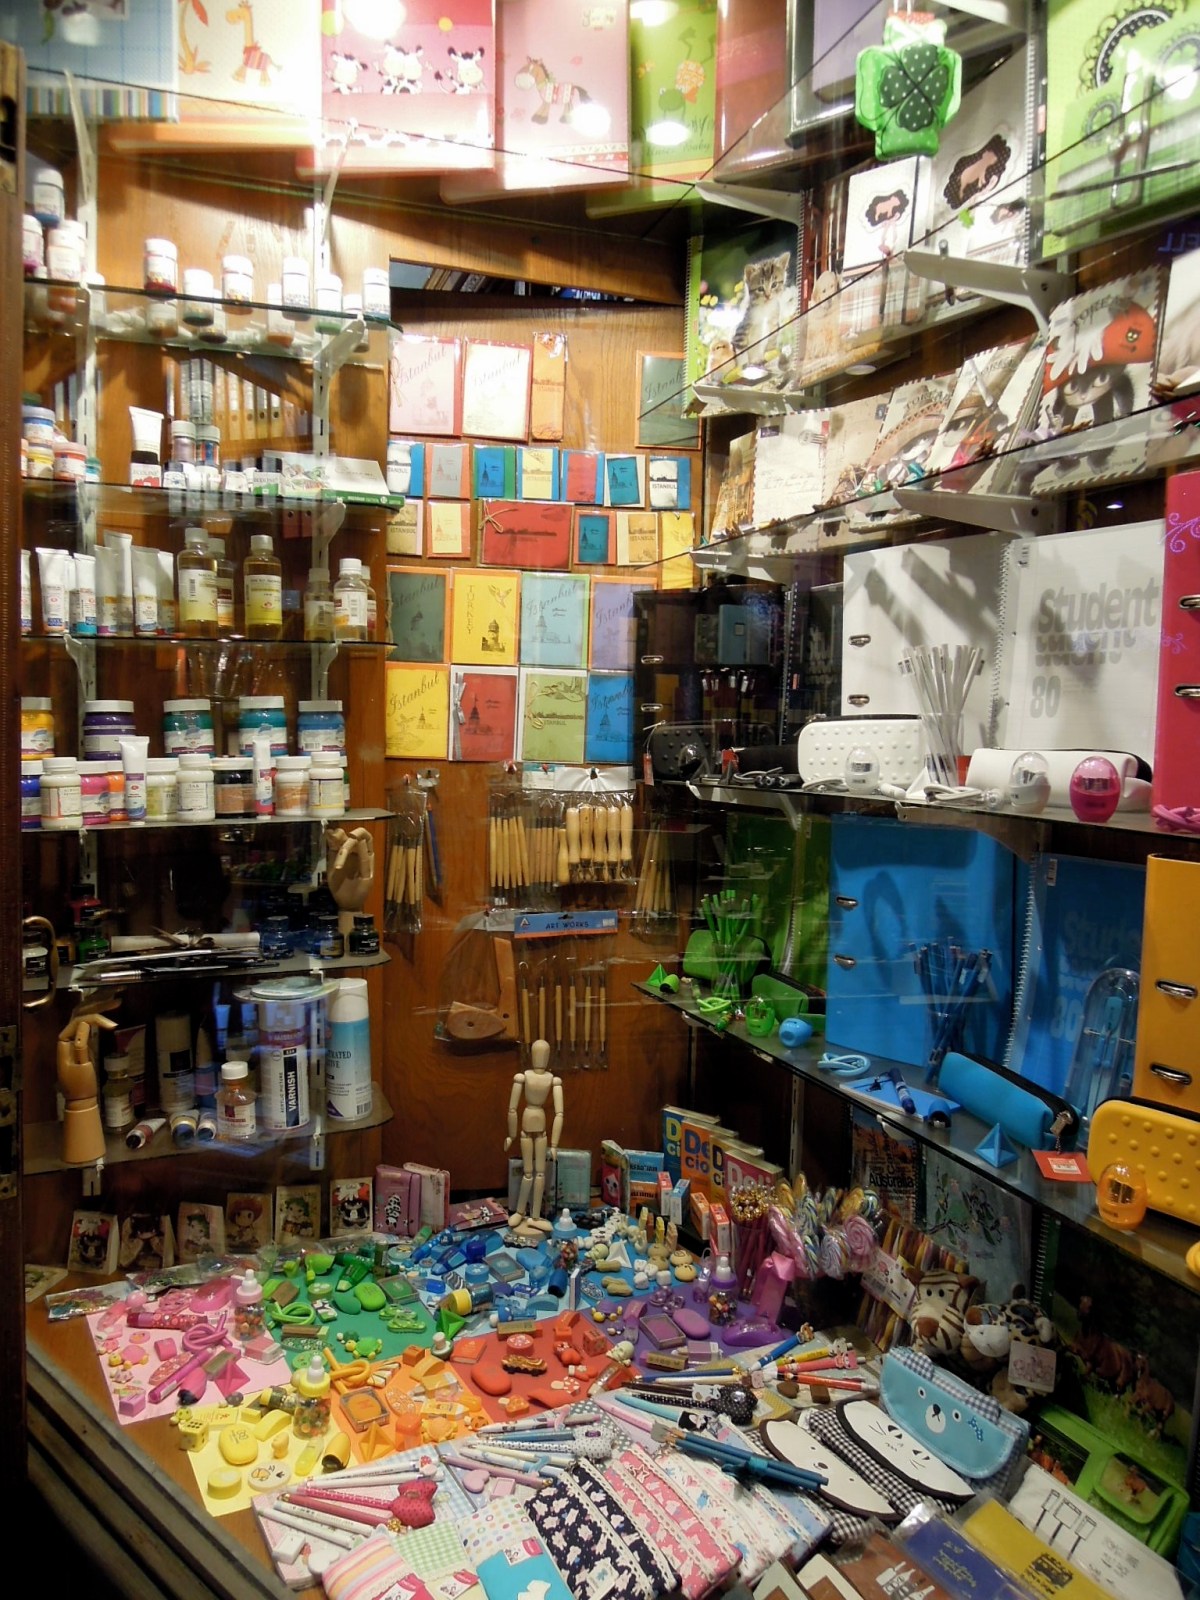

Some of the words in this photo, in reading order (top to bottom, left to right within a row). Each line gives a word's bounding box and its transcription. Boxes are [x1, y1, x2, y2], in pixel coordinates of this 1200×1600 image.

[466, 585, 475, 634] TURKEY
[1037, 577, 1160, 634] Student
[1030, 675, 1062, 719] 80
[286, 1070, 296, 1112] VARNISH
[869, 1172, 914, 1187] Australia
